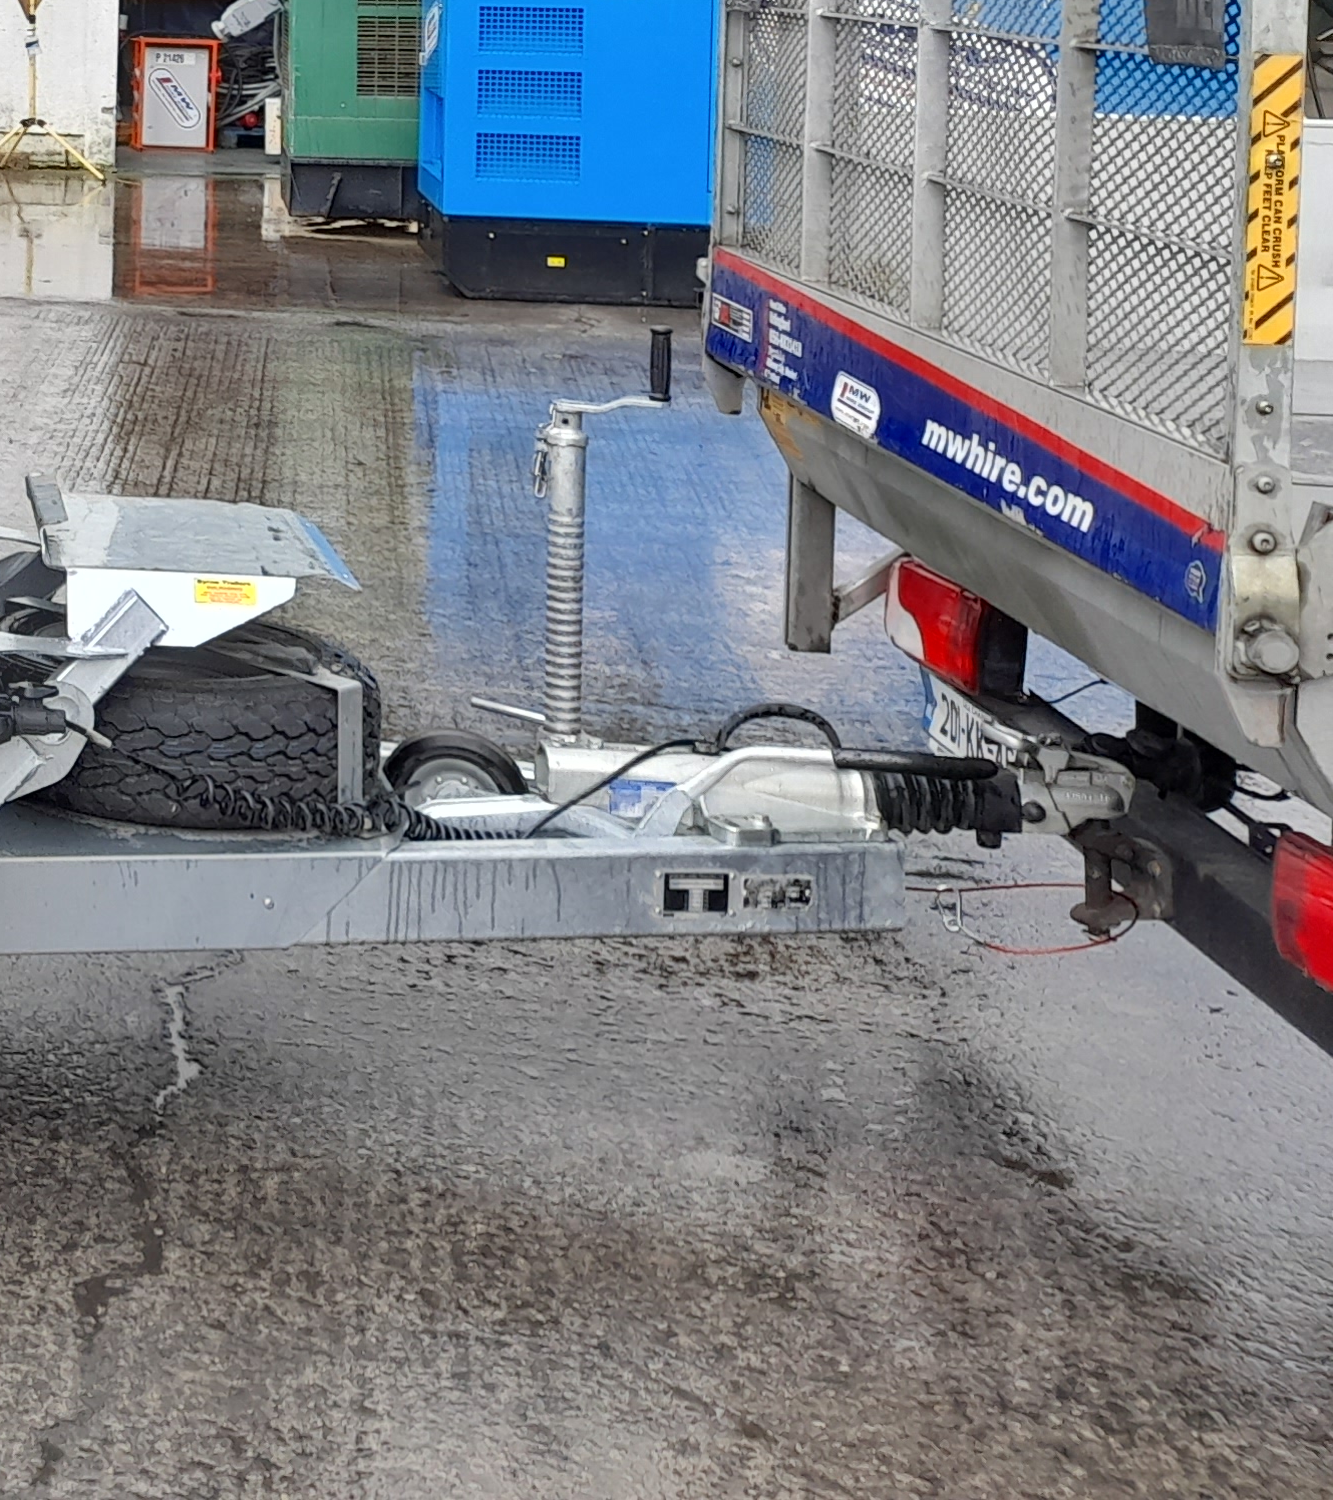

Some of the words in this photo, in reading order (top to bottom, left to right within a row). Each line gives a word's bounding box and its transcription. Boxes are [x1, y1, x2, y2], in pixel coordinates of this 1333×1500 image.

[1262, 183, 1272, 211] FEET
[1273, 199, 1283, 224] CAN
[1261, 214, 1271, 253] CLEAR
[1271, 228, 1282, 268] CRUSH
[921, 419, 1094, 533] mwhire.com
